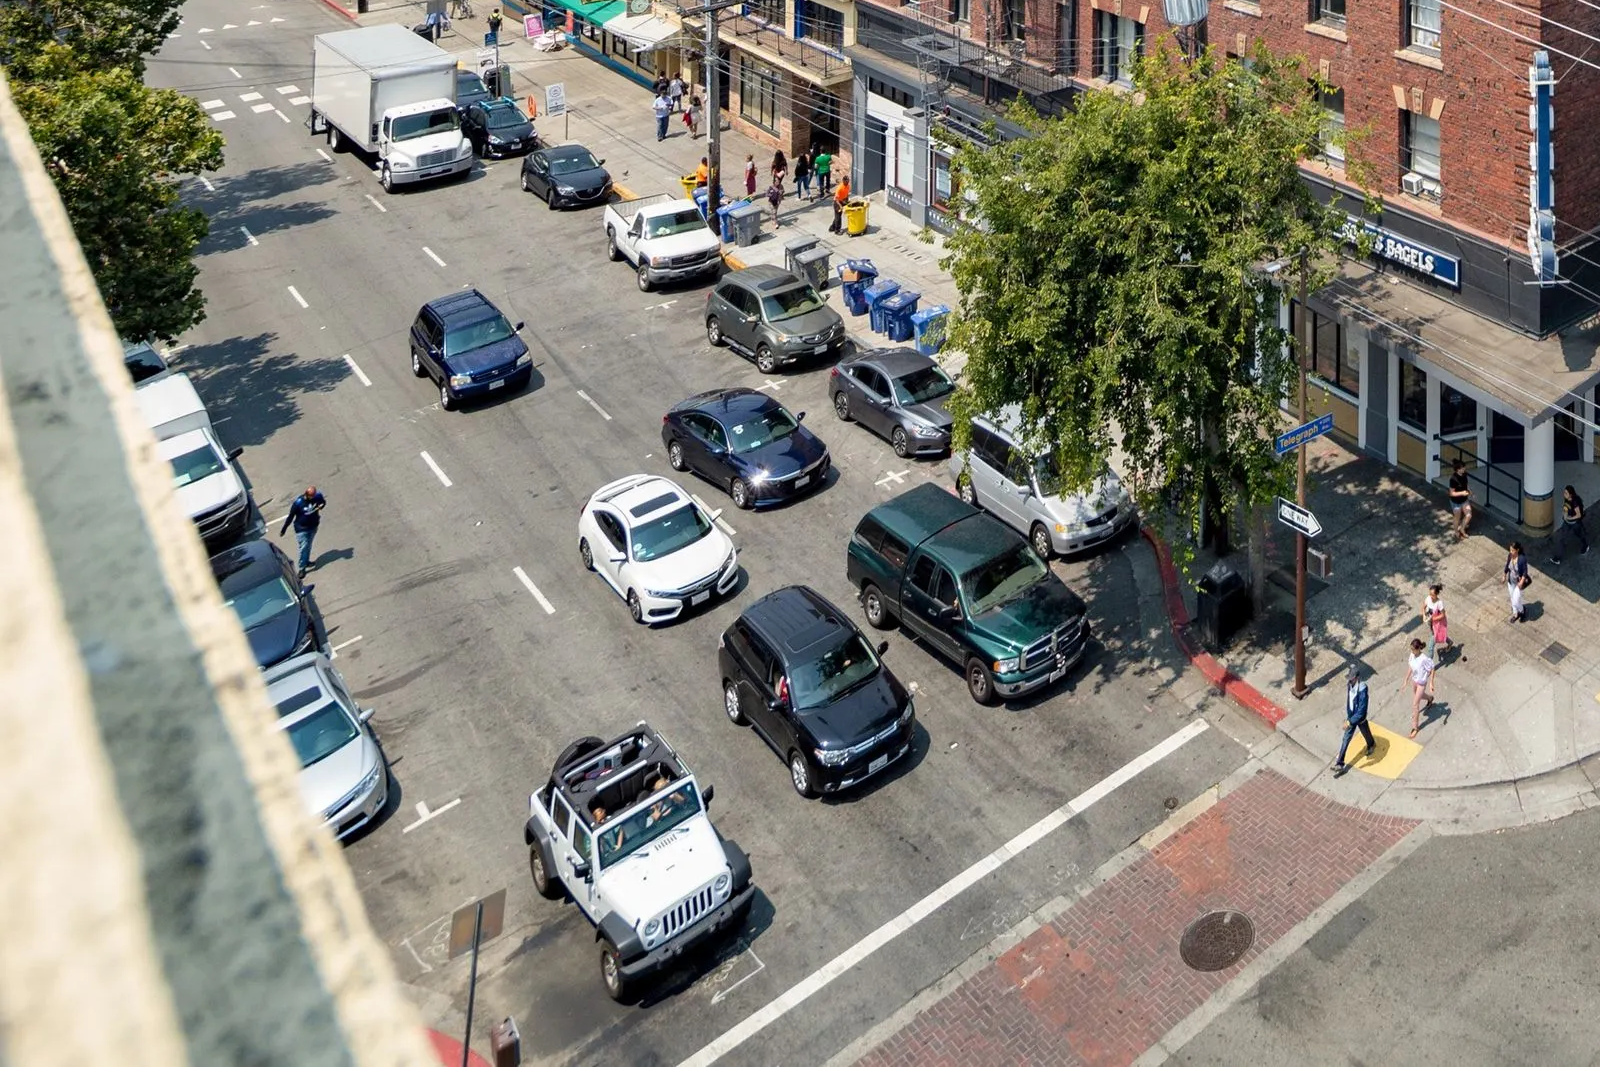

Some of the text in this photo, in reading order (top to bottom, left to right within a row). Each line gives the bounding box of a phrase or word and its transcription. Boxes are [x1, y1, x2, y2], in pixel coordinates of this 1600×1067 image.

[1386, 238, 1435, 273] BAGELS
[1280, 424, 1319, 449] Telegraph
[1282, 506, 1309, 528] ONE WAY
